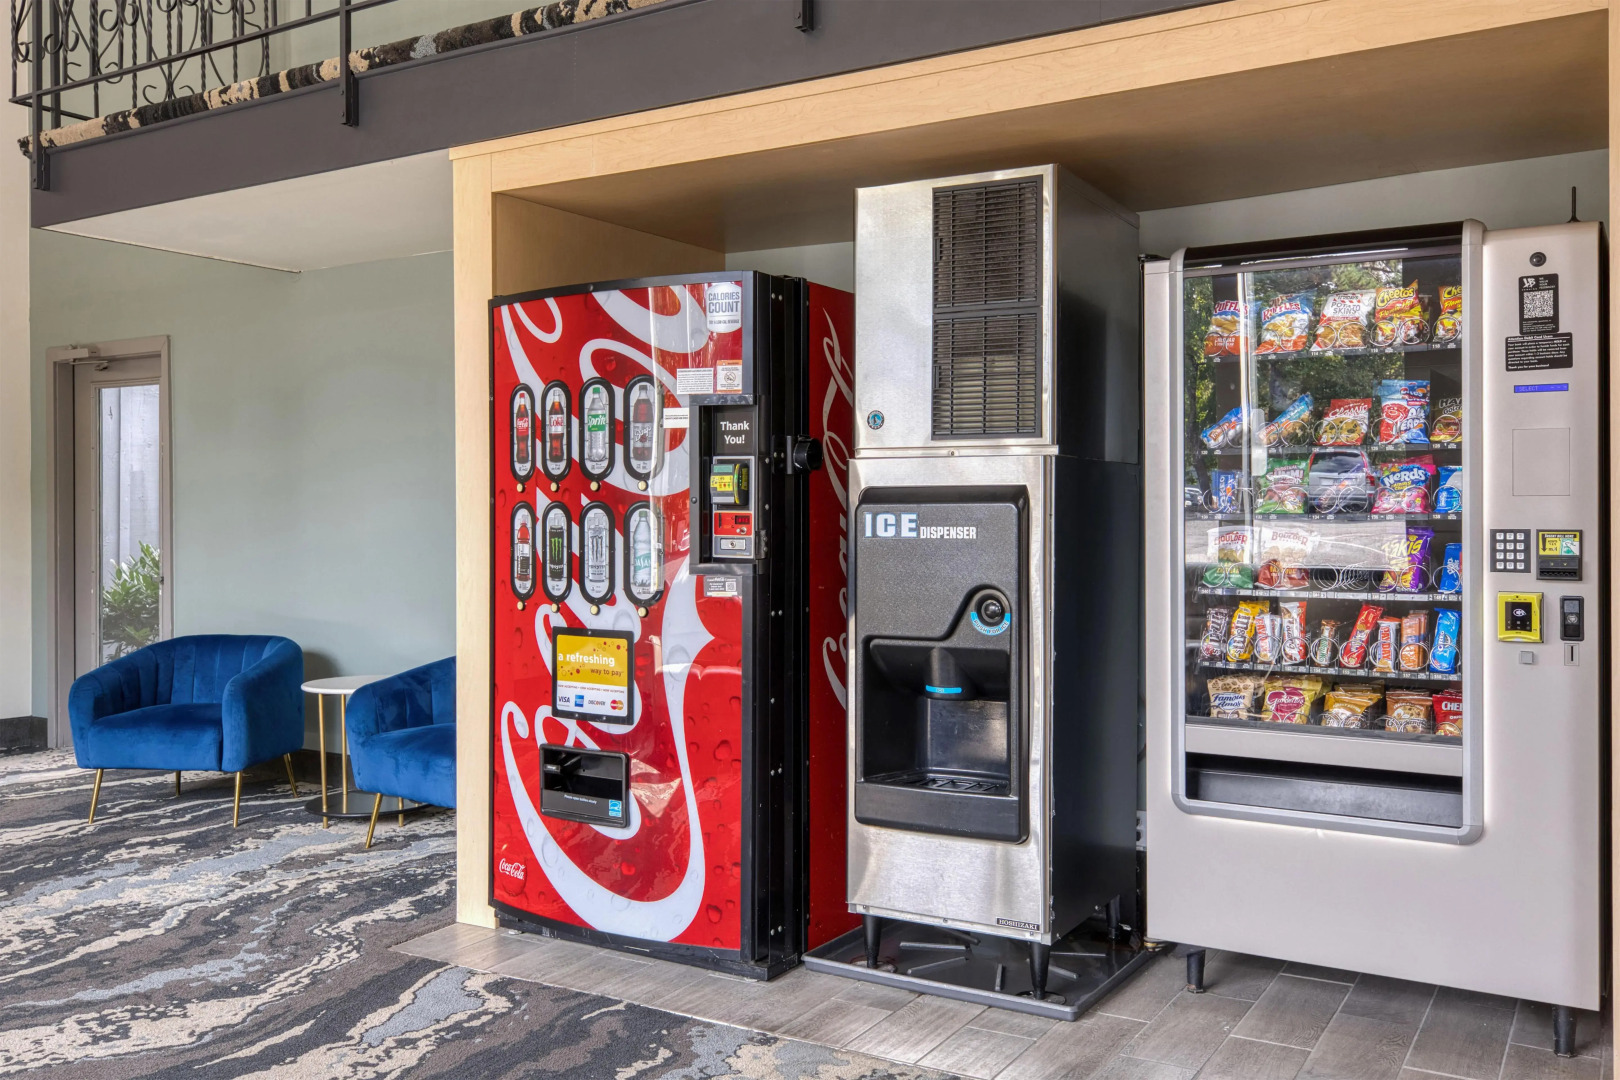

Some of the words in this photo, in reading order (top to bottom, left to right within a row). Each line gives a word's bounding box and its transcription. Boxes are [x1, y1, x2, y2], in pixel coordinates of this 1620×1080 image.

[708, 291, 740, 302] CALORIES
[1377, 287, 1415, 307] Cheetos
[708, 301, 740, 314] COUNT
[1328, 403, 1369, 419] Classic
[587, 413, 606, 427] Sprite
[720, 421, 749, 431] Thank
[724, 434, 745, 445] You!
[864, 512, 918, 538] ICE
[920, 526, 977, 539] DISPENSER
[973, 619, 988, 634] PUSH
[988, 626, 1001, 635] FOR
[1000, 621, 1009, 634] ICE
[558, 653, 564, 661] a
[567, 652, 615, 667] refreshing
[590, 668, 602, 676] way
[611, 670, 622, 678] pay
[558, 696, 571, 704] VISA
[588, 699, 606, 707] DISCOVER
[1211, 693, 1246, 705] Famous
[1216, 701, 1243, 709] Amos
[499, 858, 526, 880] Coca-Cola
[999, 919, 1037, 930] HOSHIZAKI
